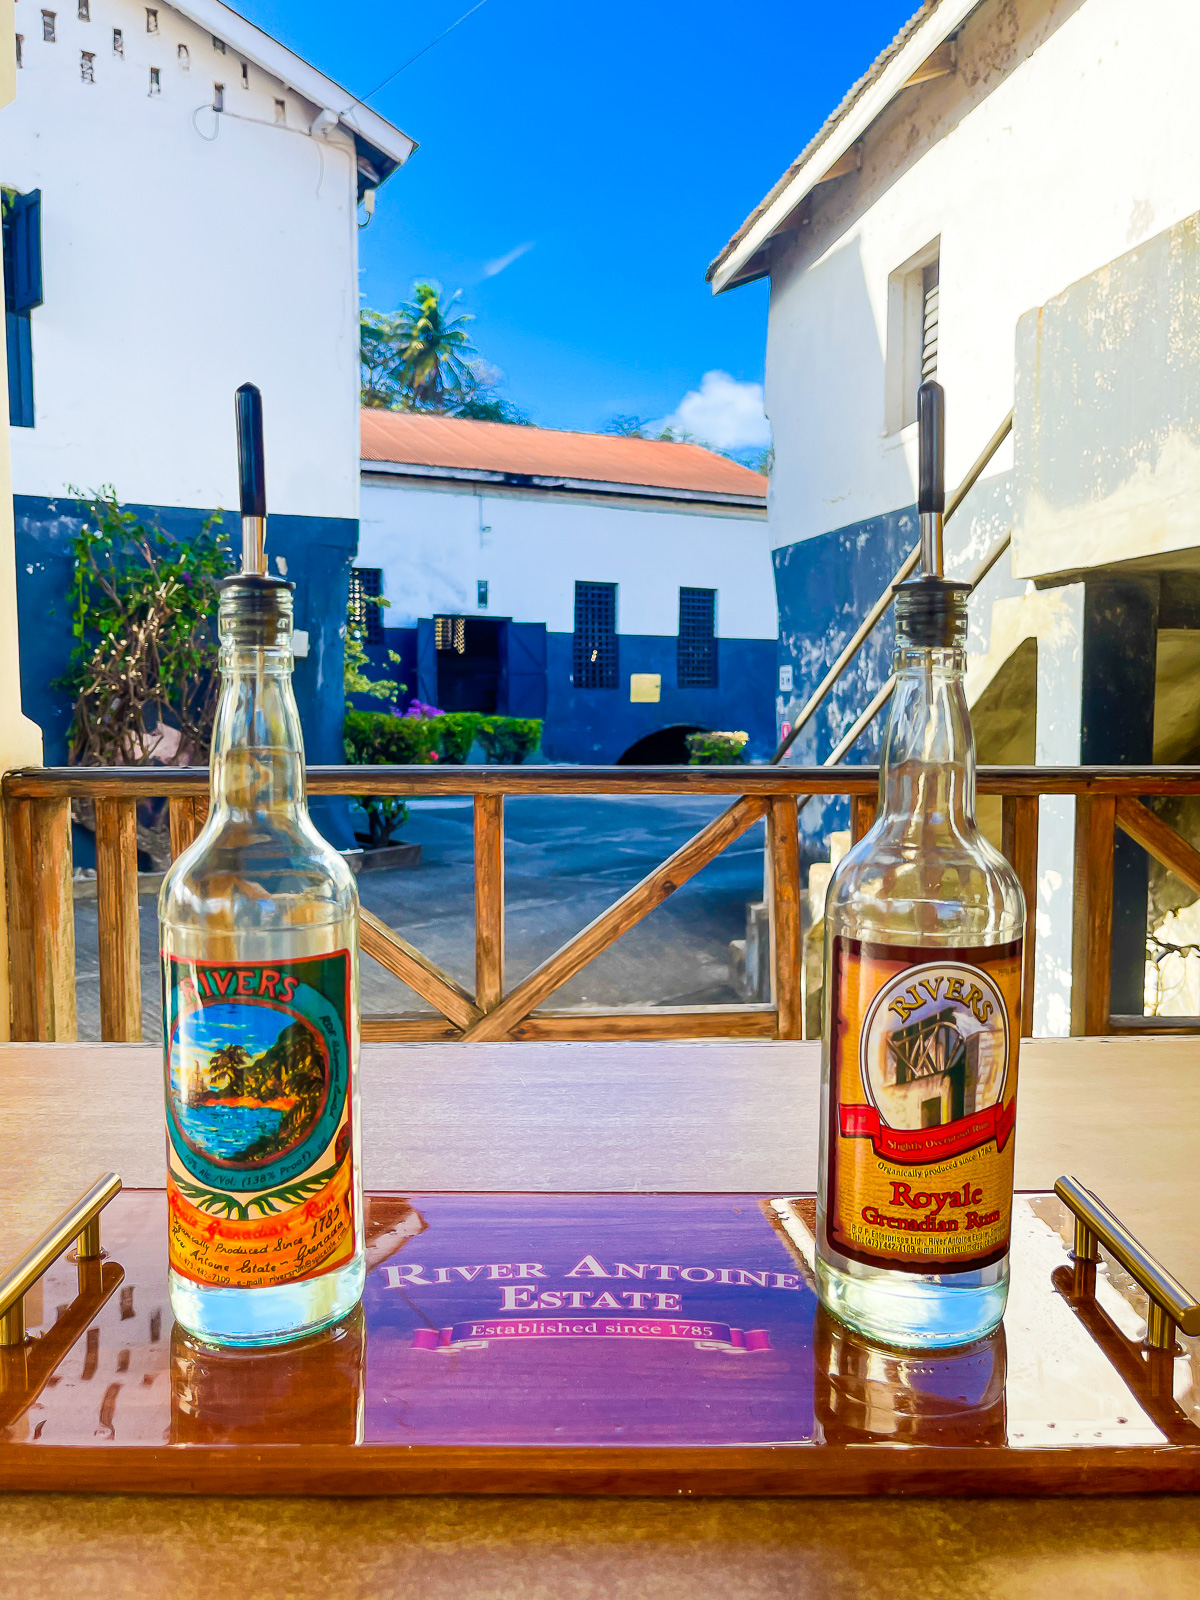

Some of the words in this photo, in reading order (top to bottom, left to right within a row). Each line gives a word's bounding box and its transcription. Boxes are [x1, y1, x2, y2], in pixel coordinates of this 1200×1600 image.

[179, 969, 299, 1003] RIVERS
[888, 976, 993, 1024] RIVERS
[887, 1139, 923, 1152] Slightly
[972, 1122, 990, 1134] Rum
[183, 1154, 198, 1170] 69%
[241, 1171, 276, 1188] (138%
[280, 1150, 311, 1176] Proof)
[877, 1161, 922, 1178] Organically
[923, 1161, 958, 1178] produced
[959, 1155, 976, 1167] since
[889, 1181, 983, 1216] Royale
[173, 1214, 211, 1255] Organically
[214, 1243, 269, 1255] Produced
[272, 1237, 303, 1253] Since
[311, 1203, 340, 1240] 1785
[201, 1220, 291, 1243] Grenadian
[300, 1194, 335, 1225] Rum
[861, 1206, 959, 1233] Grenadian
[965, 1209, 1000, 1232] Rum
[172, 1226, 186, 1249] River
[190, 1249, 230, 1272] Antoine
[235, 1260, 277, 1274] Estate
[293, 1221, 344, 1268] Grenada
[871, 1230, 909, 1244] Enterprises
[928, 1237, 947, 1246] River
[883, 1241, 915, 1253] 442-7109
[381, 1262, 548, 1289] RIVER
[563, 1254, 801, 1291] ANTOINE
[499, 1285, 683, 1312] ESTATE
[470, 1323, 598, 1336] Established
[605, 1325, 662, 1335] since
[669, 1324, 714, 1337] 1785
